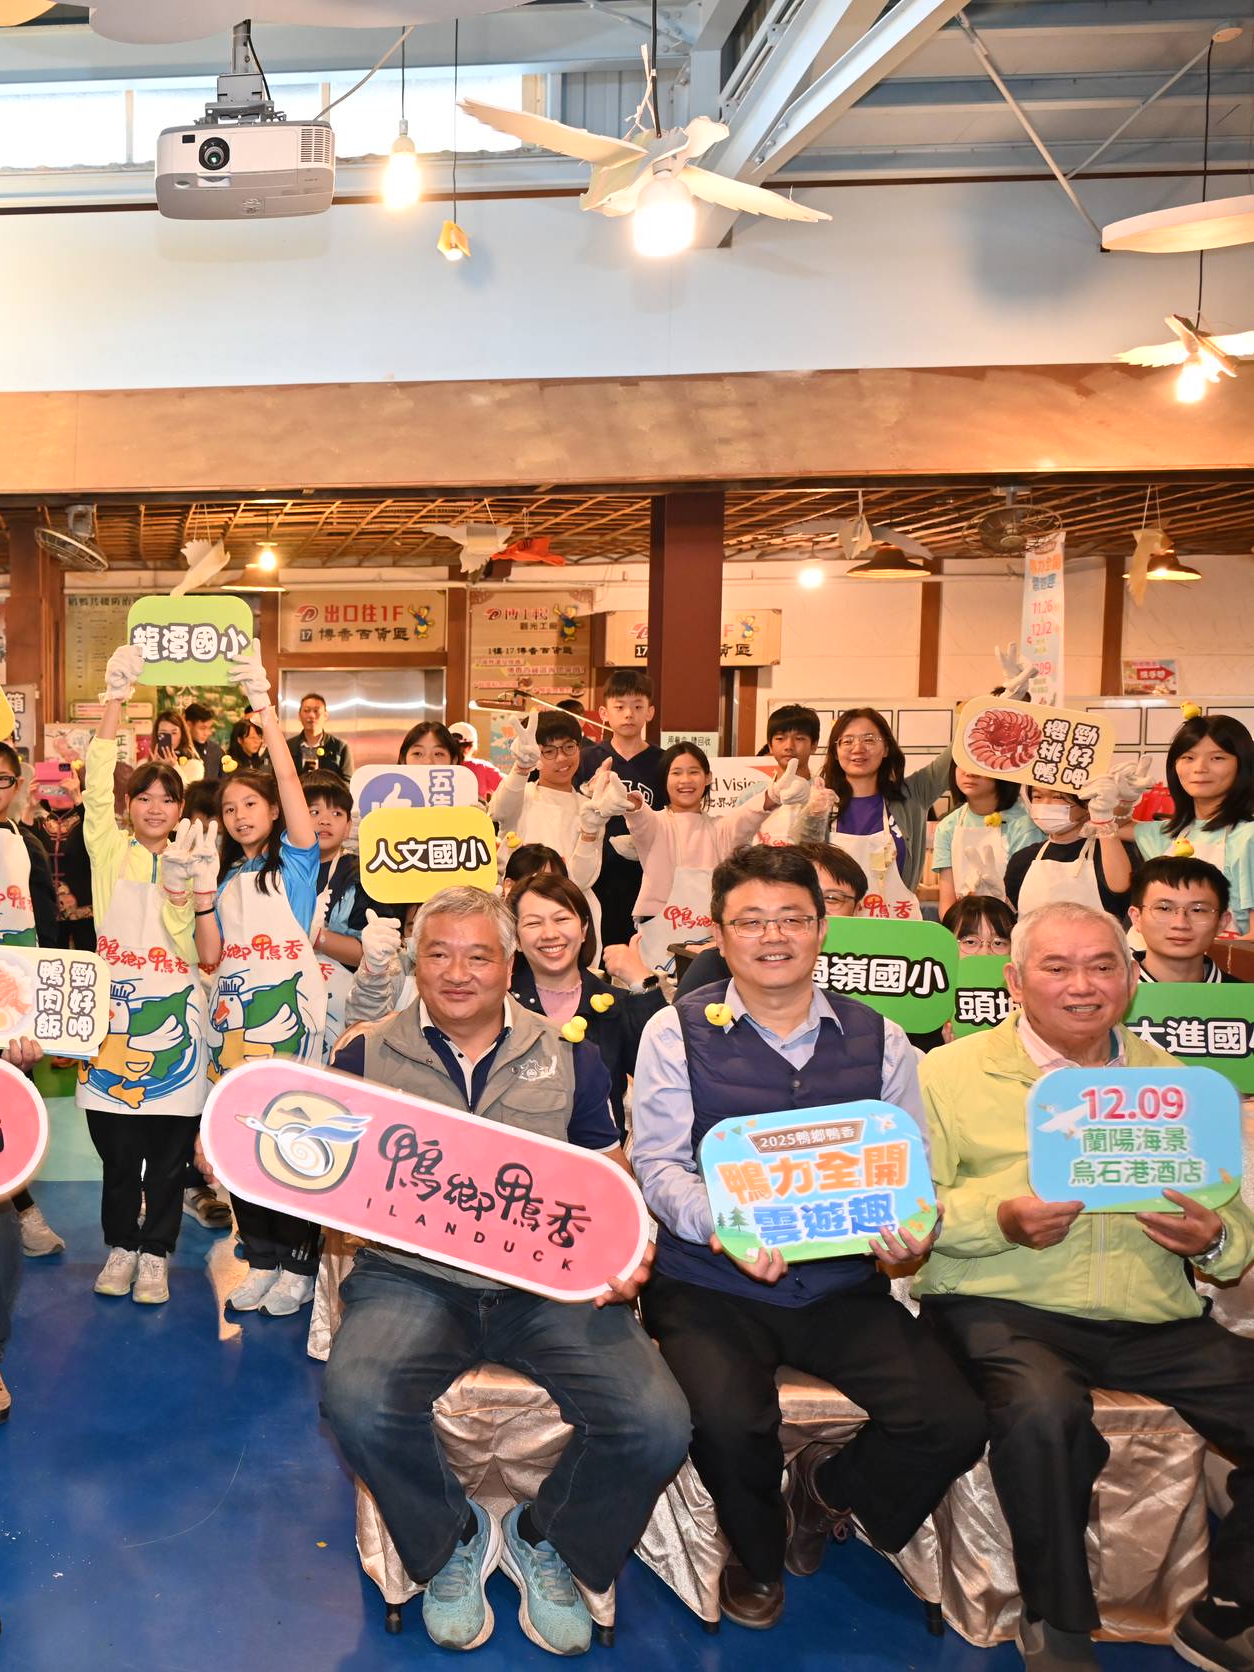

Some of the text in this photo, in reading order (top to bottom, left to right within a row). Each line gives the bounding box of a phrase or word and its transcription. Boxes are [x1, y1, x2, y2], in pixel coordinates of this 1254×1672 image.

[132, 624, 249, 661] 龍潭國小
[300, 627, 410, 642] 17 博香百貨區
[1033, 719, 1070, 784] 櫻桃鴨
[1063, 723, 1099, 790] 勁好呷
[368, 839, 488, 871] 人文國小
[219, 934, 304, 961] 鄉鴨香
[35, 959, 65, 1039] 鴨肉飯
[67, 961, 97, 1041] 勁好呷
[1126, 1019, 1254, 1056] 大進國
[1081, 1086, 1186, 1121] 12.09
[759, 1124, 856, 1150] 2025鴨鄉鴨香
[1081, 1126, 1188, 1154] 蘭陽海景
[718, 1140, 911, 1204] 鴨力全開
[1069, 1157, 1203, 1186] 烏石港酒店
[366, 1196, 574, 1271] ILANDUCK
[753, 1192, 897, 1248] 雲遊趣
